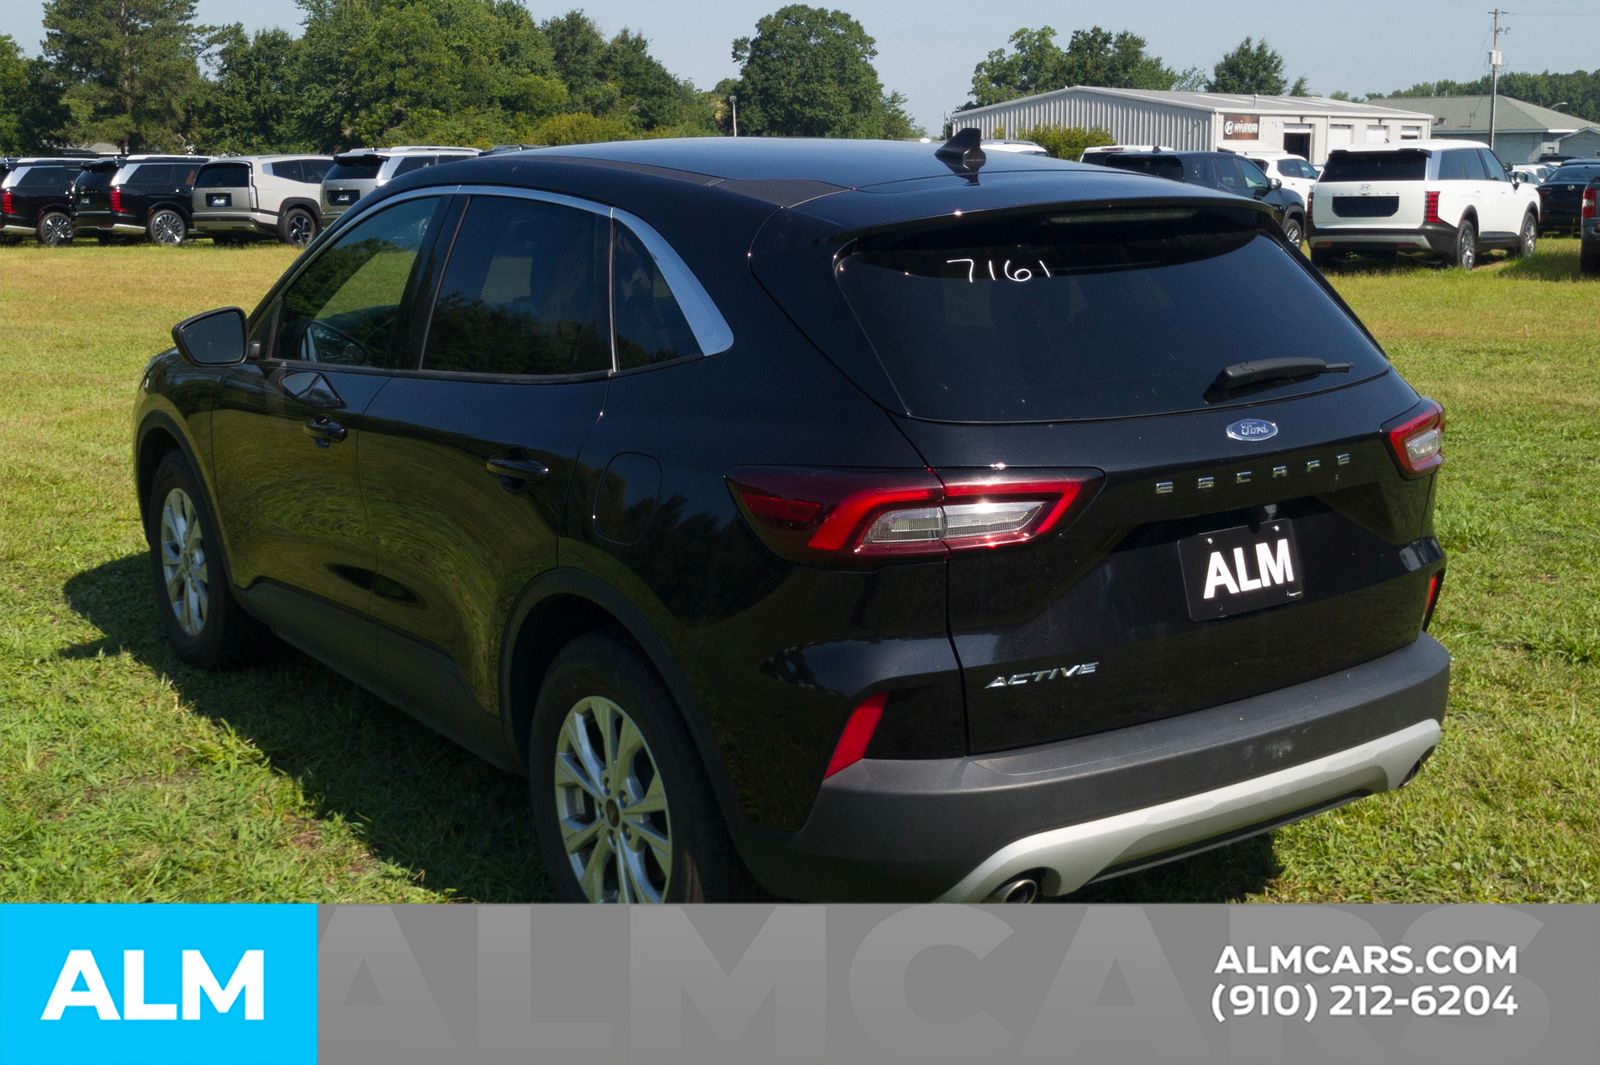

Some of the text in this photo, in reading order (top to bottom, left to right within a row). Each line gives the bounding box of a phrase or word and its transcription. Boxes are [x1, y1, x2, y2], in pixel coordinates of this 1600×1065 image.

[946, 259, 1051, 283] 7161
[1240, 421, 1269, 436] Ford
[1156, 453, 1350, 495] ESCAPE
[1203, 538, 1295, 599] ALM
[984, 662, 1099, 689] ACTIVE
